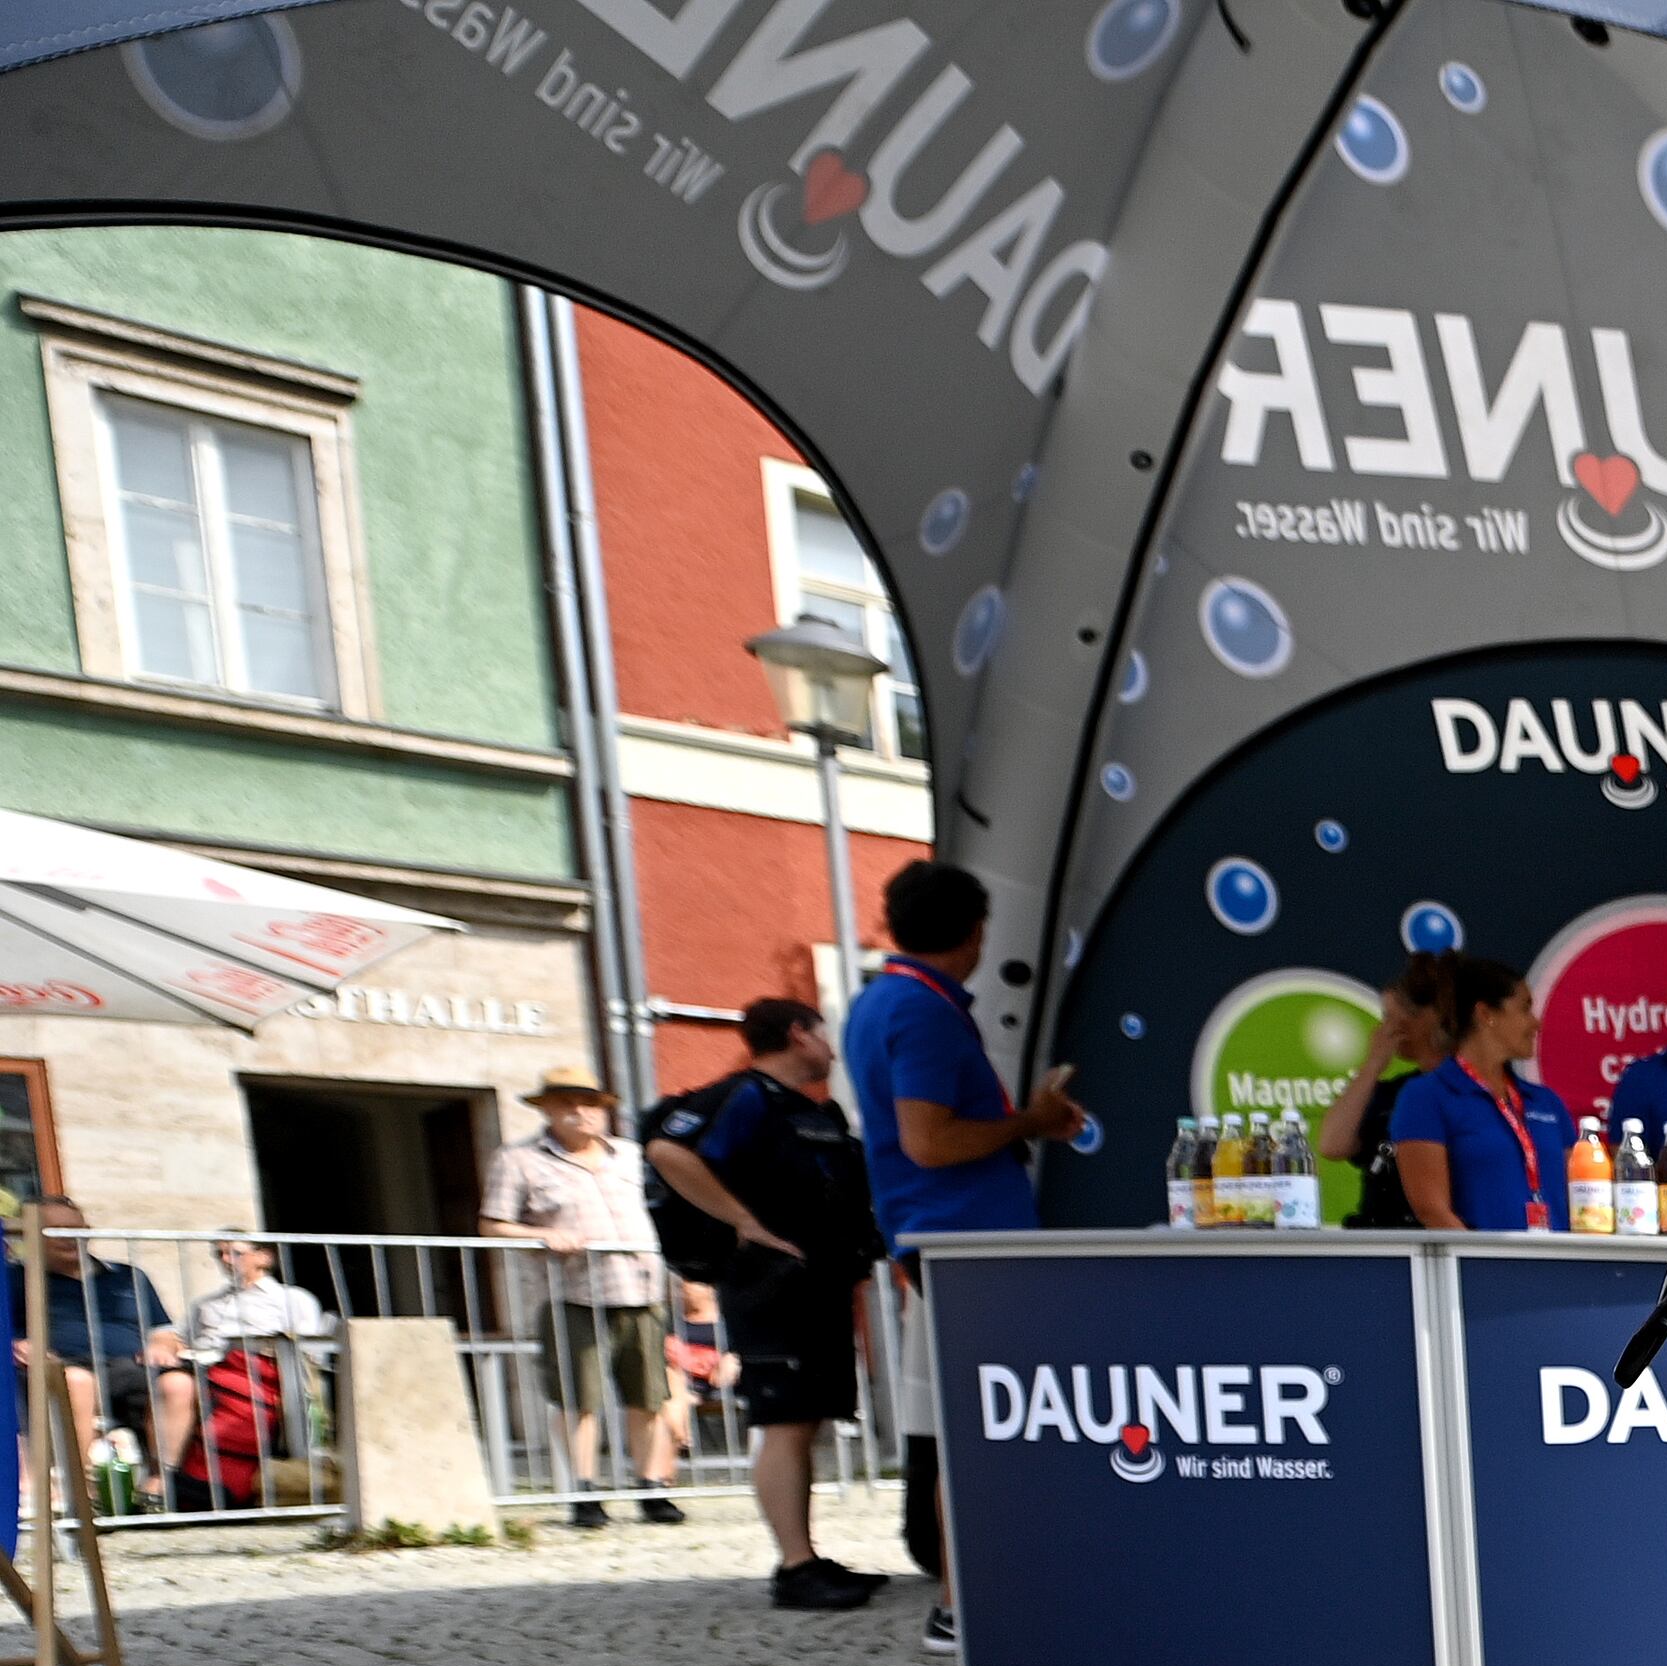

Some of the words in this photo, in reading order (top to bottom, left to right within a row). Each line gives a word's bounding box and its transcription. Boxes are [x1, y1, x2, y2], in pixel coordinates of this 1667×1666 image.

[1227, 1069, 1357, 1109] Magnes
[978, 1363, 1331, 1445] DAUNER
[1176, 1455, 1208, 1480] Wir
[1211, 1455, 1252, 1480] sind
[1256, 1456, 1334, 1481] Wasser.
